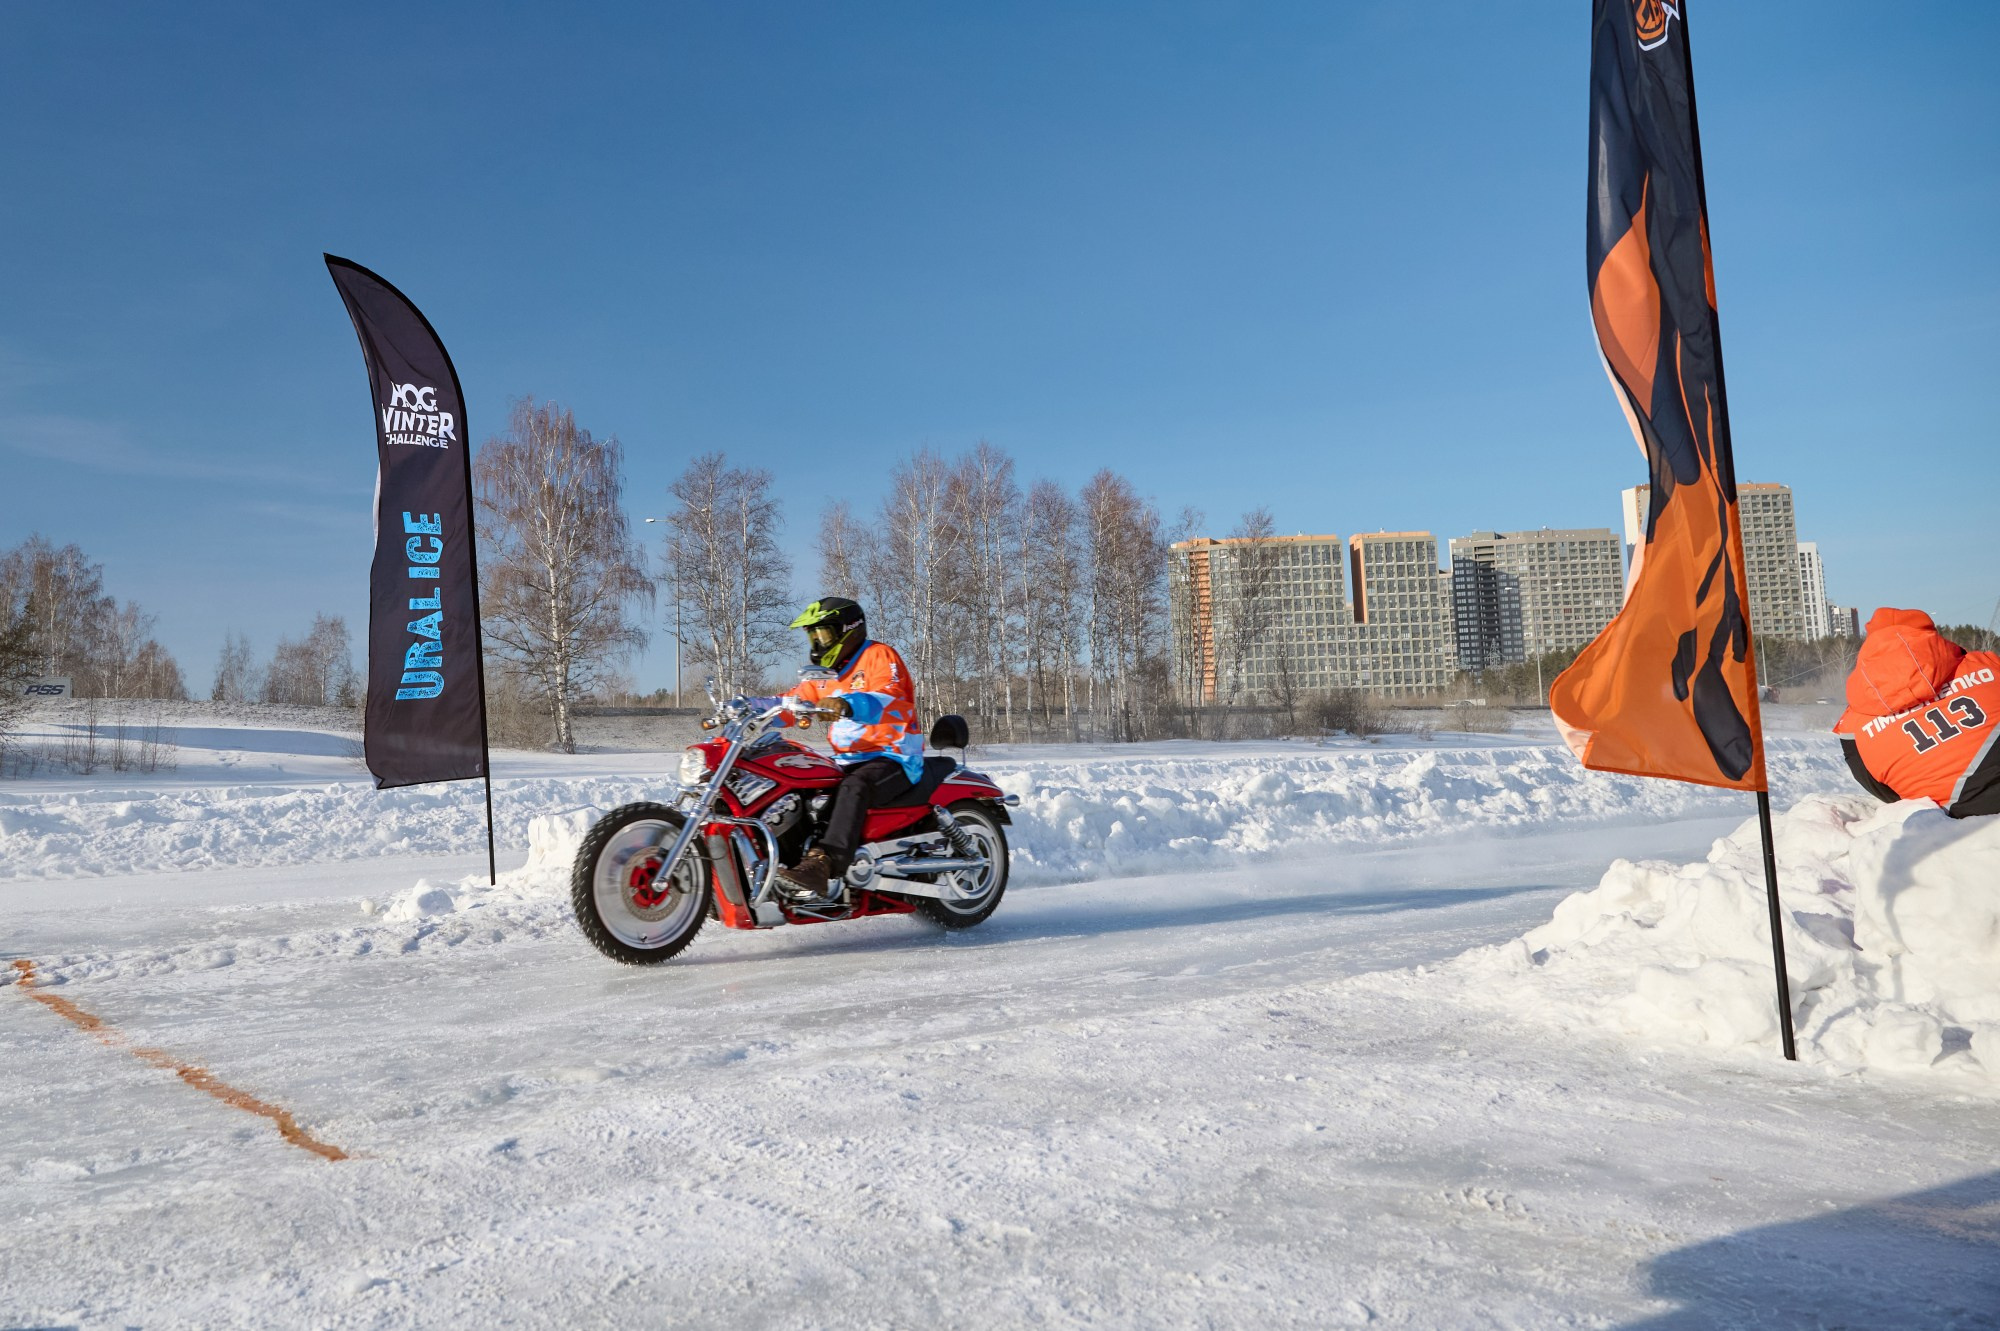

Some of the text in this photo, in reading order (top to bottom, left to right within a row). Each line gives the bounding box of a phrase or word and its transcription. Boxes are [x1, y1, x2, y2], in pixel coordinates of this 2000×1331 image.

[396, 511, 444, 700] URAL ICE
[24, 685, 65, 695] PSS
[1902, 695, 1987, 755] 113
